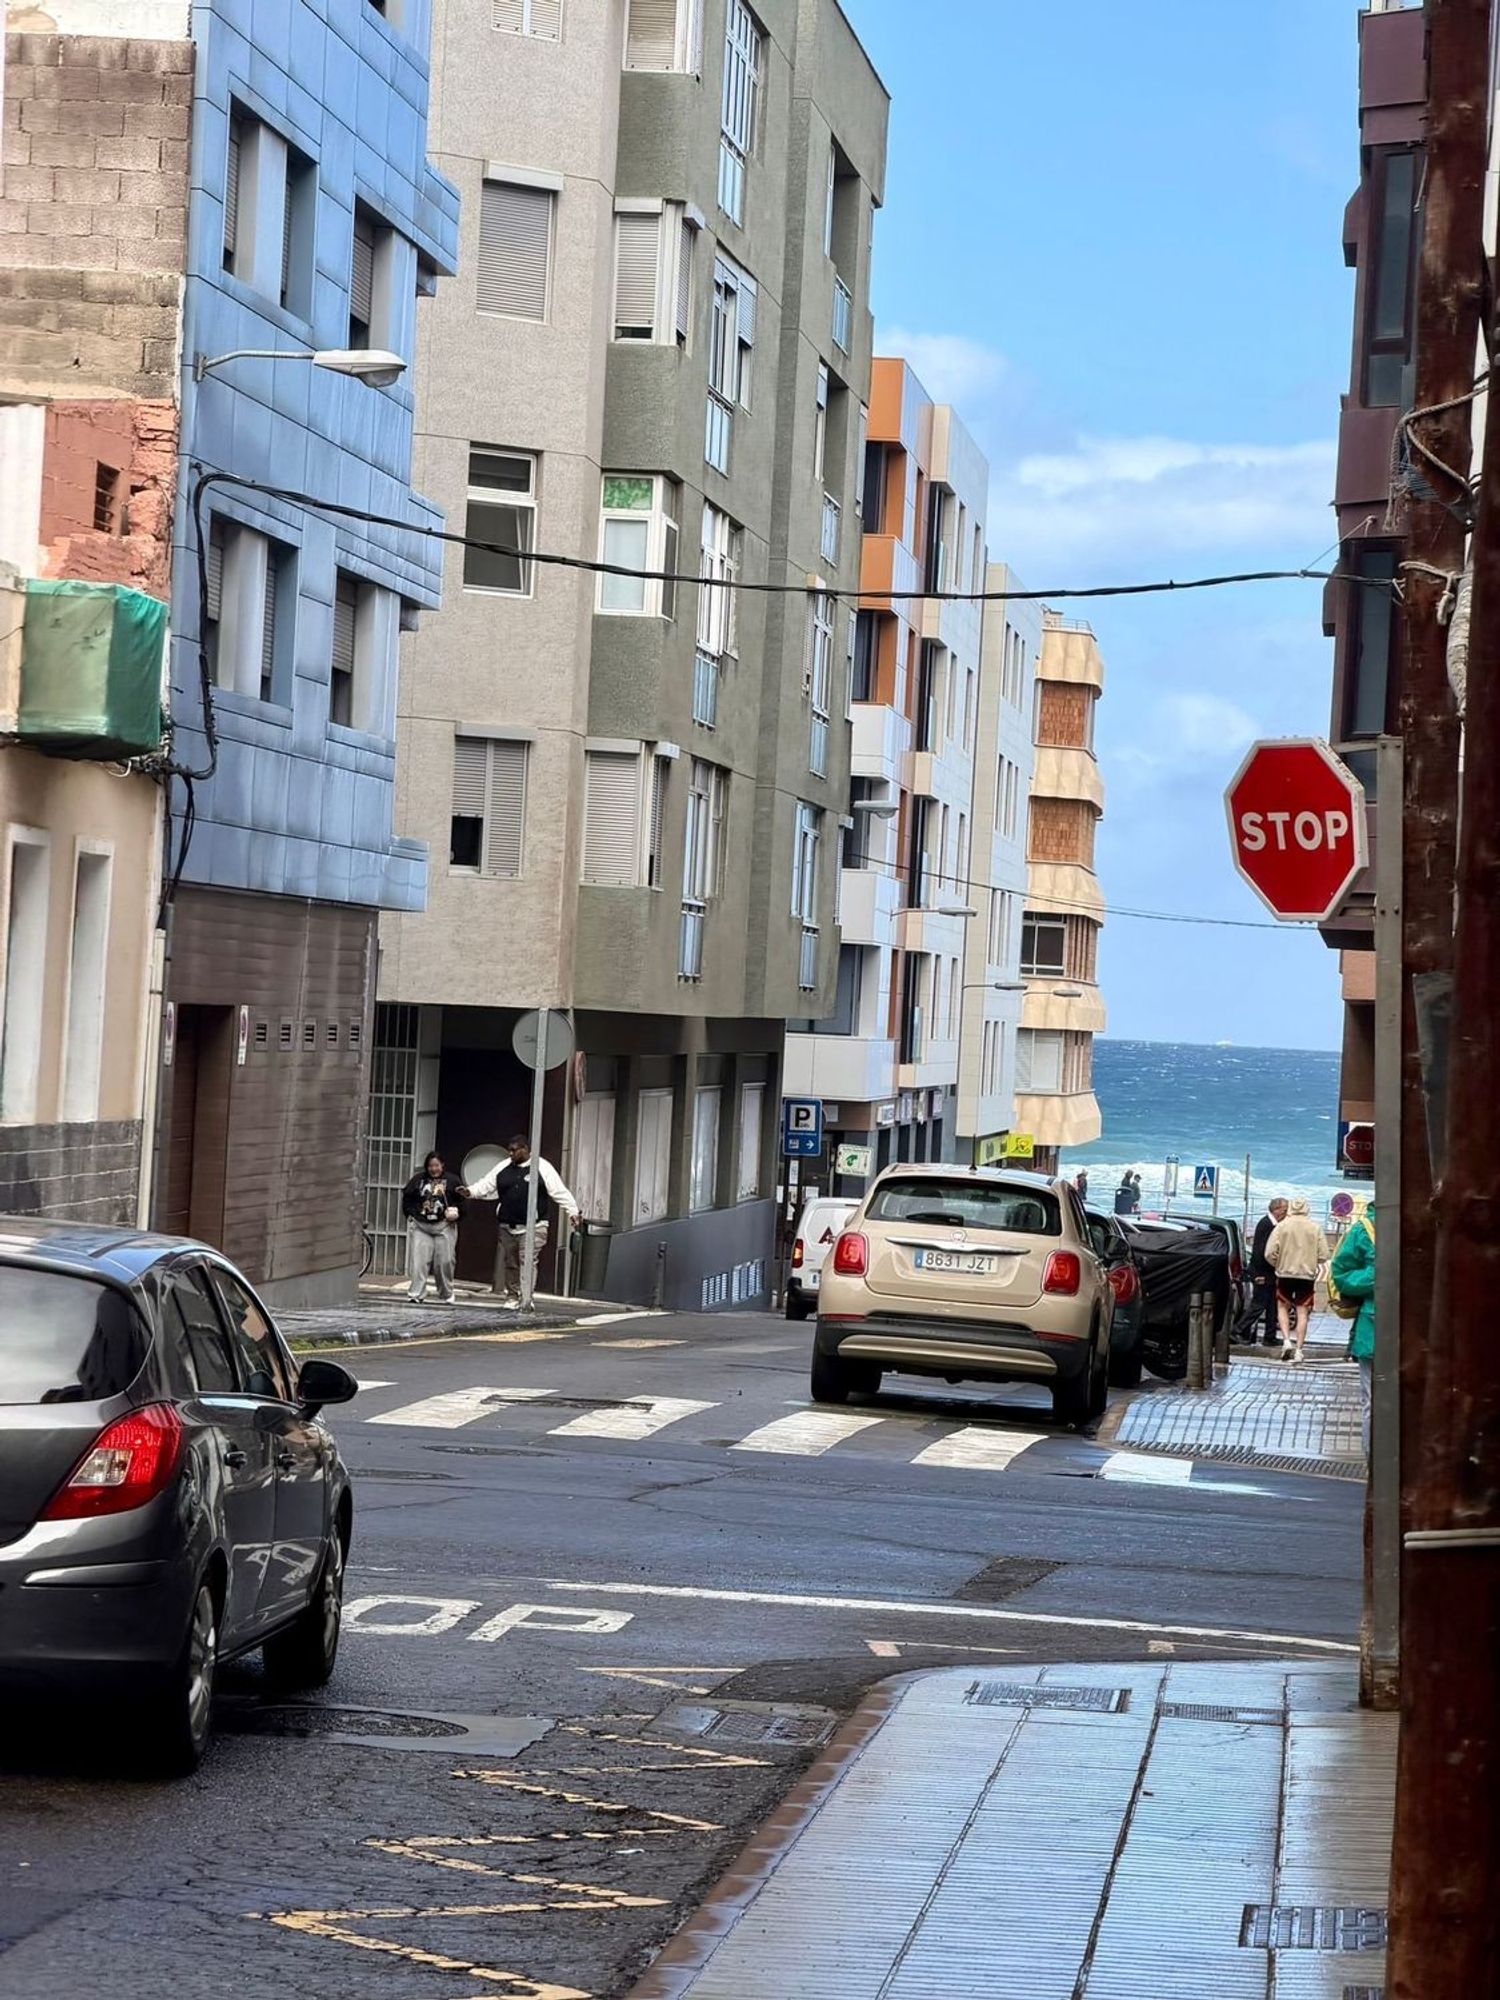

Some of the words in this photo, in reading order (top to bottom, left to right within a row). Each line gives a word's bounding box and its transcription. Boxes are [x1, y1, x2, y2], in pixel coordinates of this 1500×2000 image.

[1241, 811, 1348, 851] STOP
[795, 1107, 810, 1128] P
[1348, 1140, 1373, 1150] STO
[926, 1252, 960, 1268] 8631
[967, 1256, 994, 1271] JZT
[341, 1594, 635, 1642] OP
